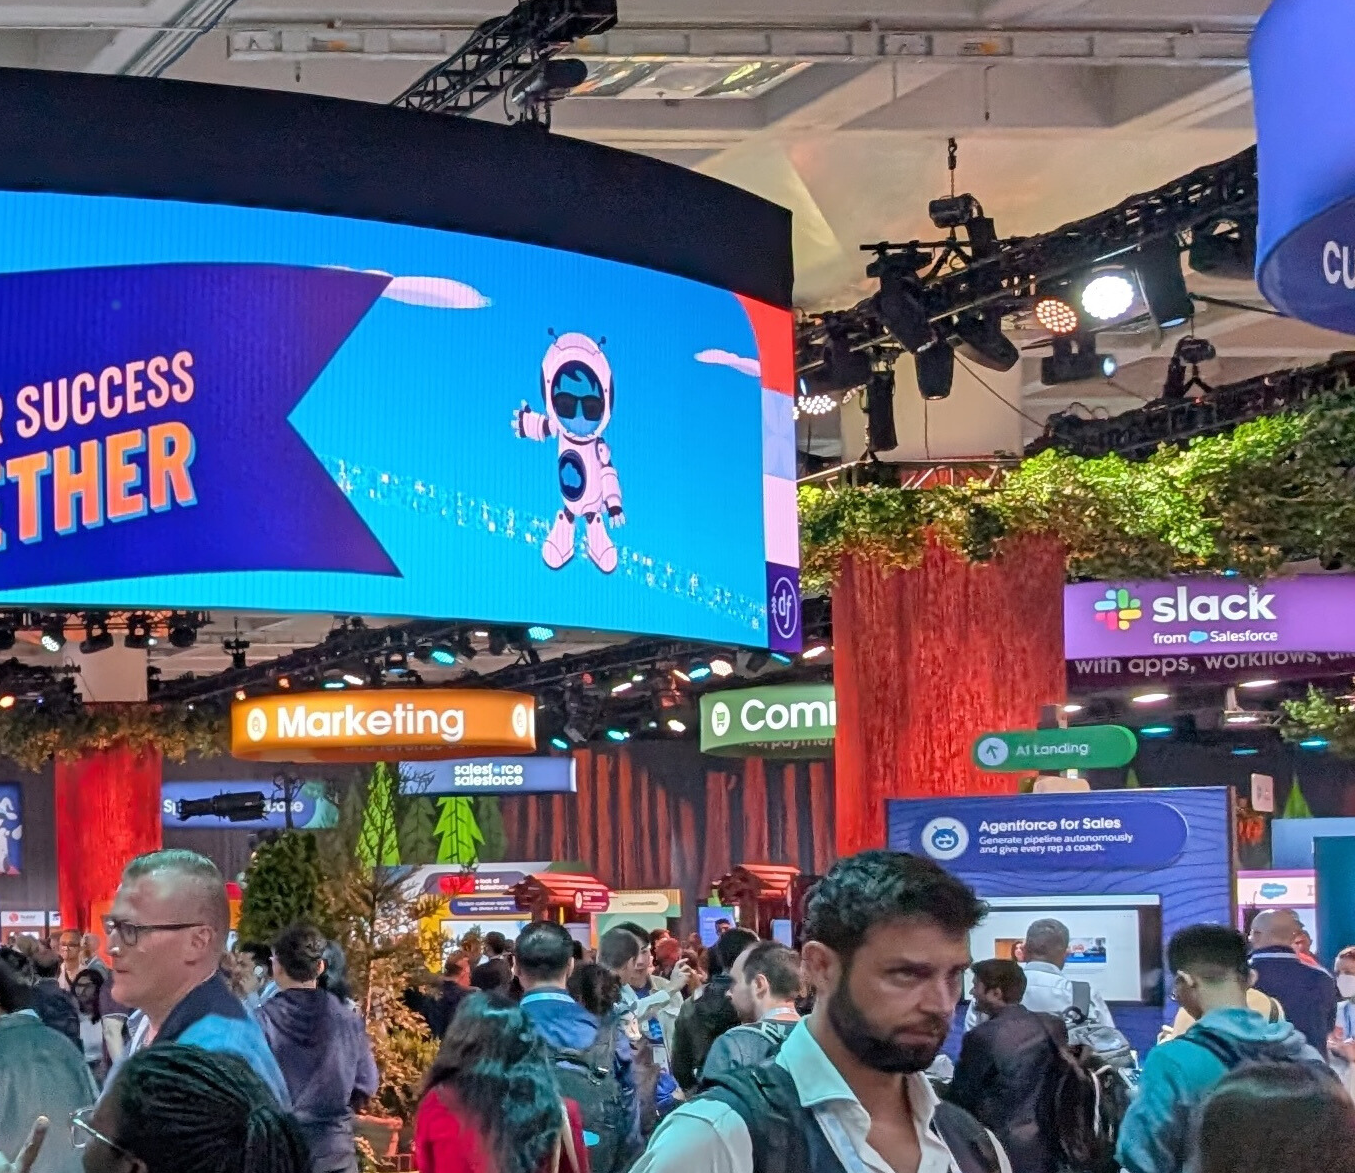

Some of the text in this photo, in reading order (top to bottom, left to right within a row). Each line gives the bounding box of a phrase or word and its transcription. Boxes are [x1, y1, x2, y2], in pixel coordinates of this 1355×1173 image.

[16, 350, 195, 437] SUCCESS
[1152, 585, 1277, 623] slack
[1153, 630, 1278, 644] from Salesforce
[1128, 656, 1196, 676] apps,
[277, 703, 465, 742] Marketing
[1034, 742, 1089, 756] Landing
[454, 774, 523, 787] salesforce
[979, 817, 1121, 835] Agentforce for Sales
[979, 832, 1133, 845] Generate pipeline autonomously
[979, 845, 997, 854] and
[999, 844, 1018, 855] give
[1020, 844, 1045, 854] every
[1047, 845, 1063, 855] rep
[1074, 842, 1105, 851] coach.
